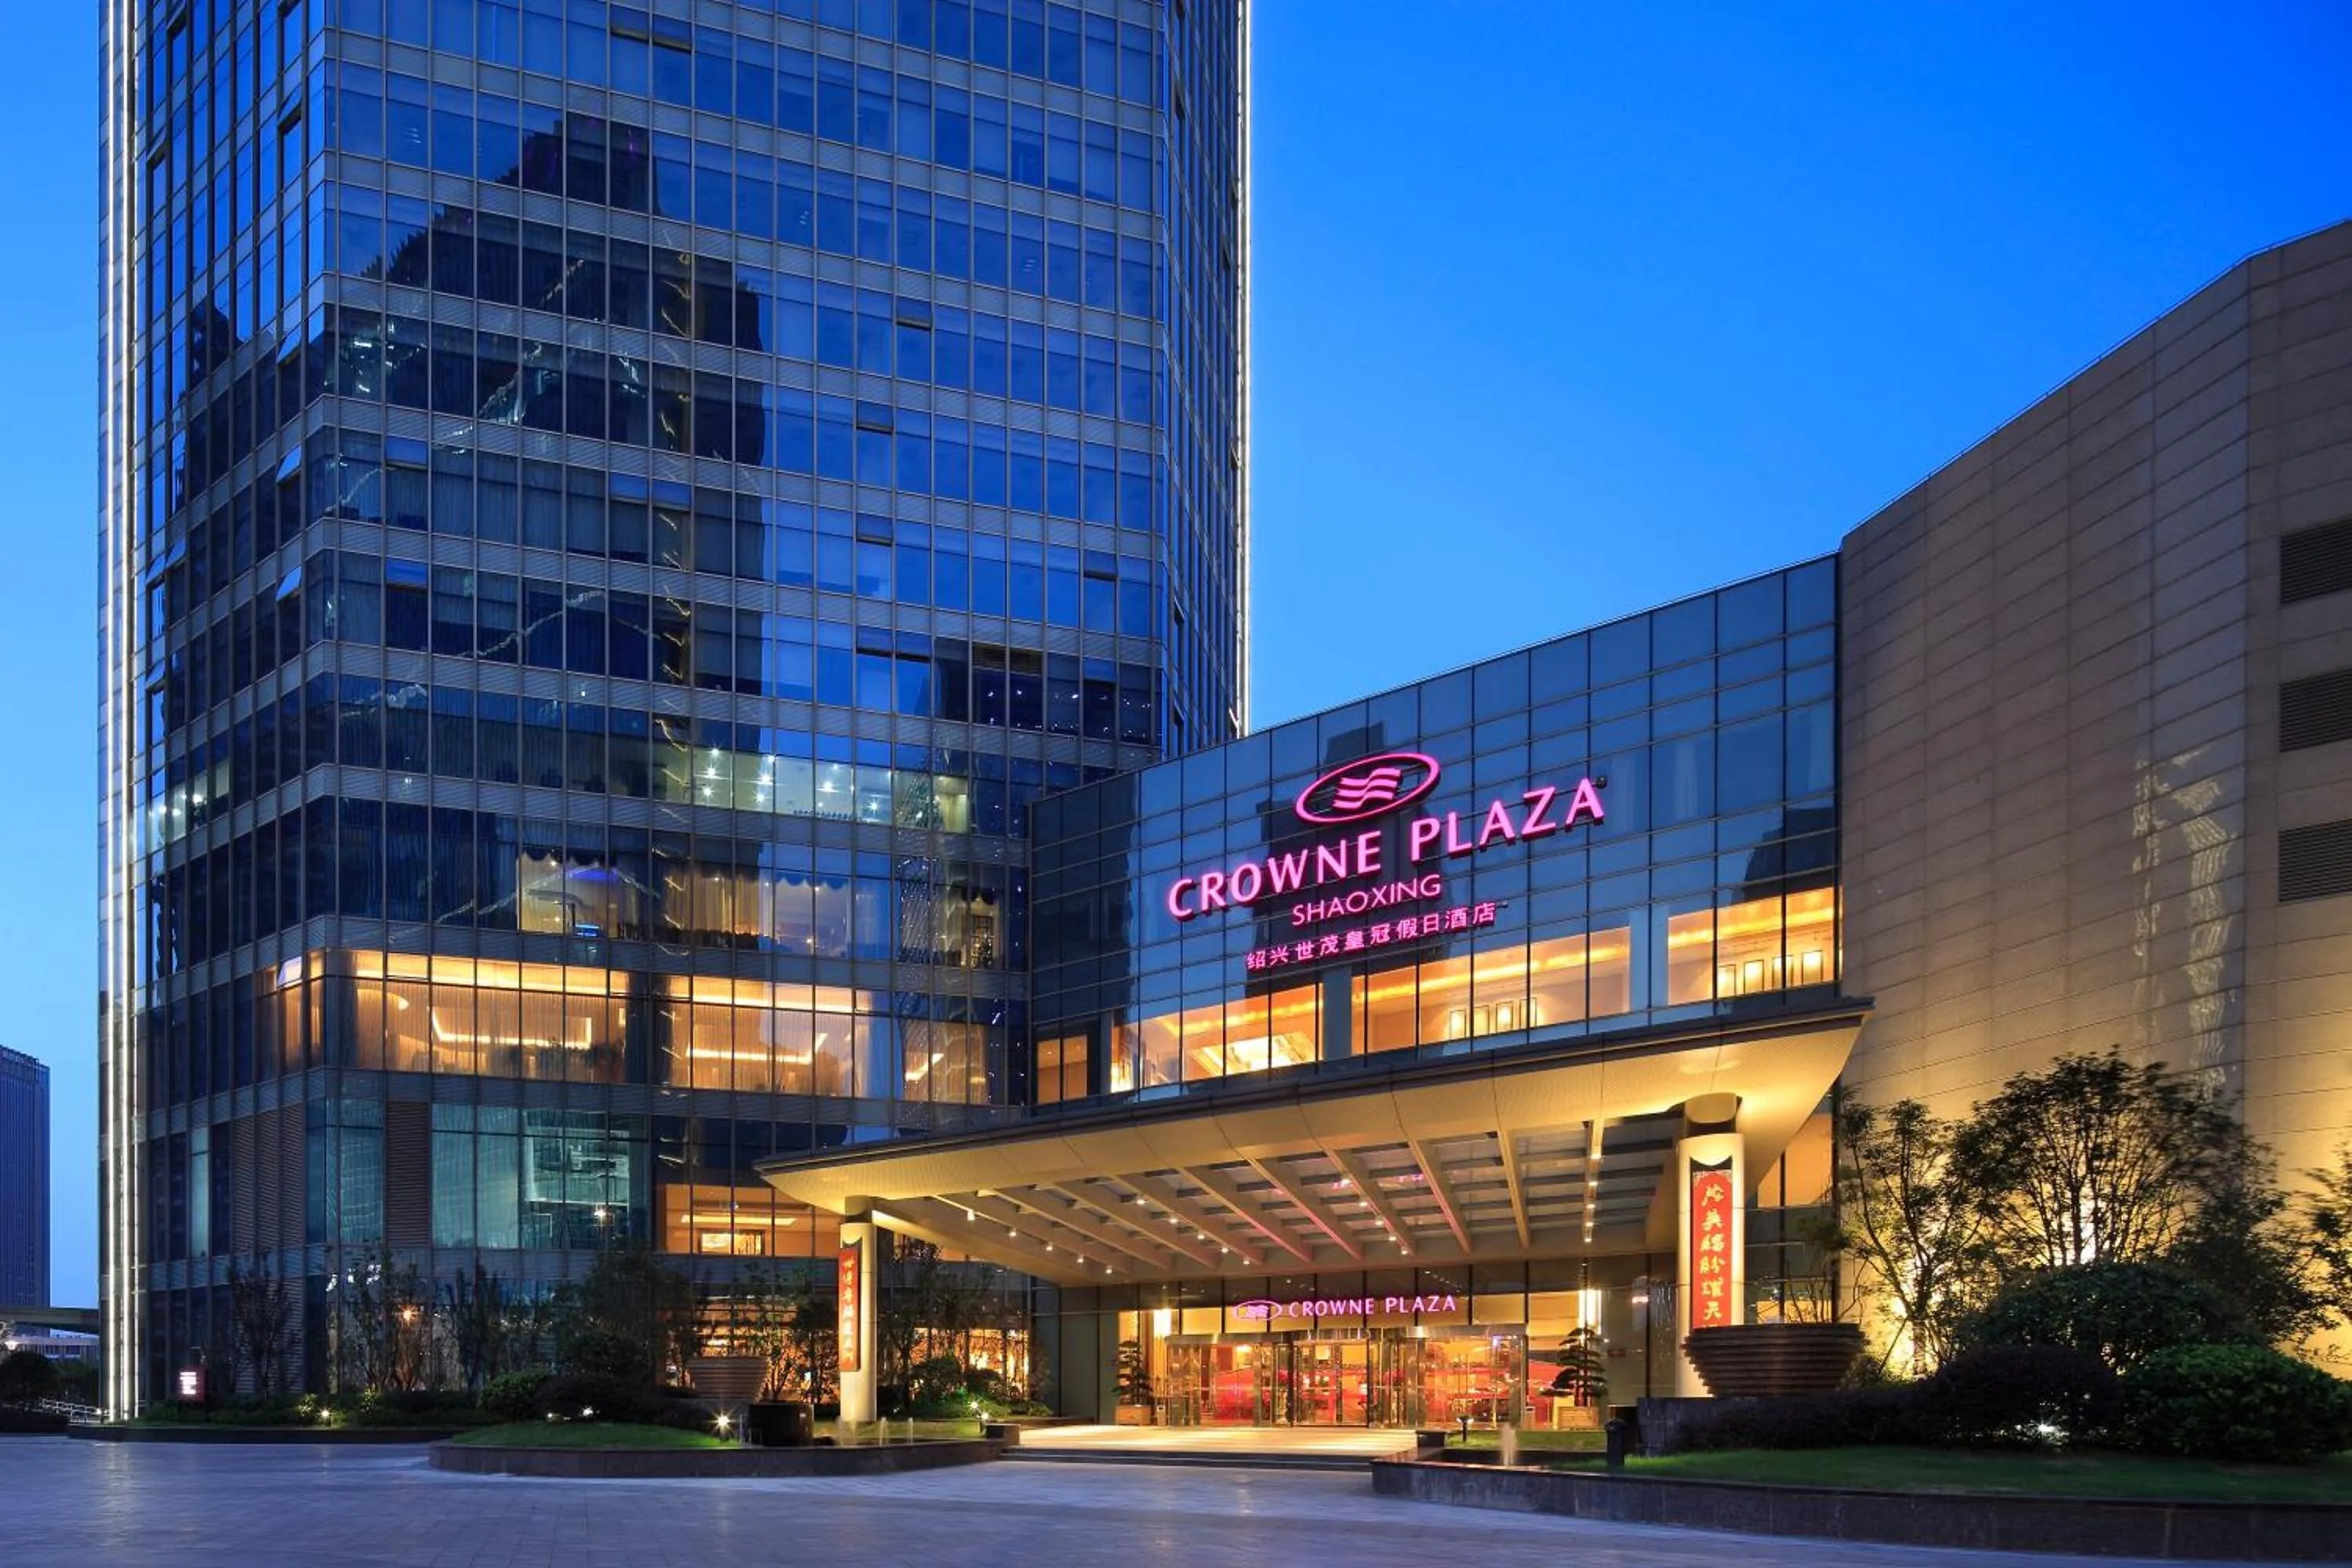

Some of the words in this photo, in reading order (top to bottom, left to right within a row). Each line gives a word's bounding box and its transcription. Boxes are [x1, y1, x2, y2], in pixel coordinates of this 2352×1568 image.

[1168, 830, 1381, 919] CROWNE
[1410, 777, 1605, 863] PLAZA
[1291, 874, 1441, 926] SHAOXING
[1247, 902, 1496, 971] 绍兴世茂皇冠假日酒店
[1288, 1297, 1374, 1318] CROWNE
[1385, 1294, 1457, 1314] PLAZA
